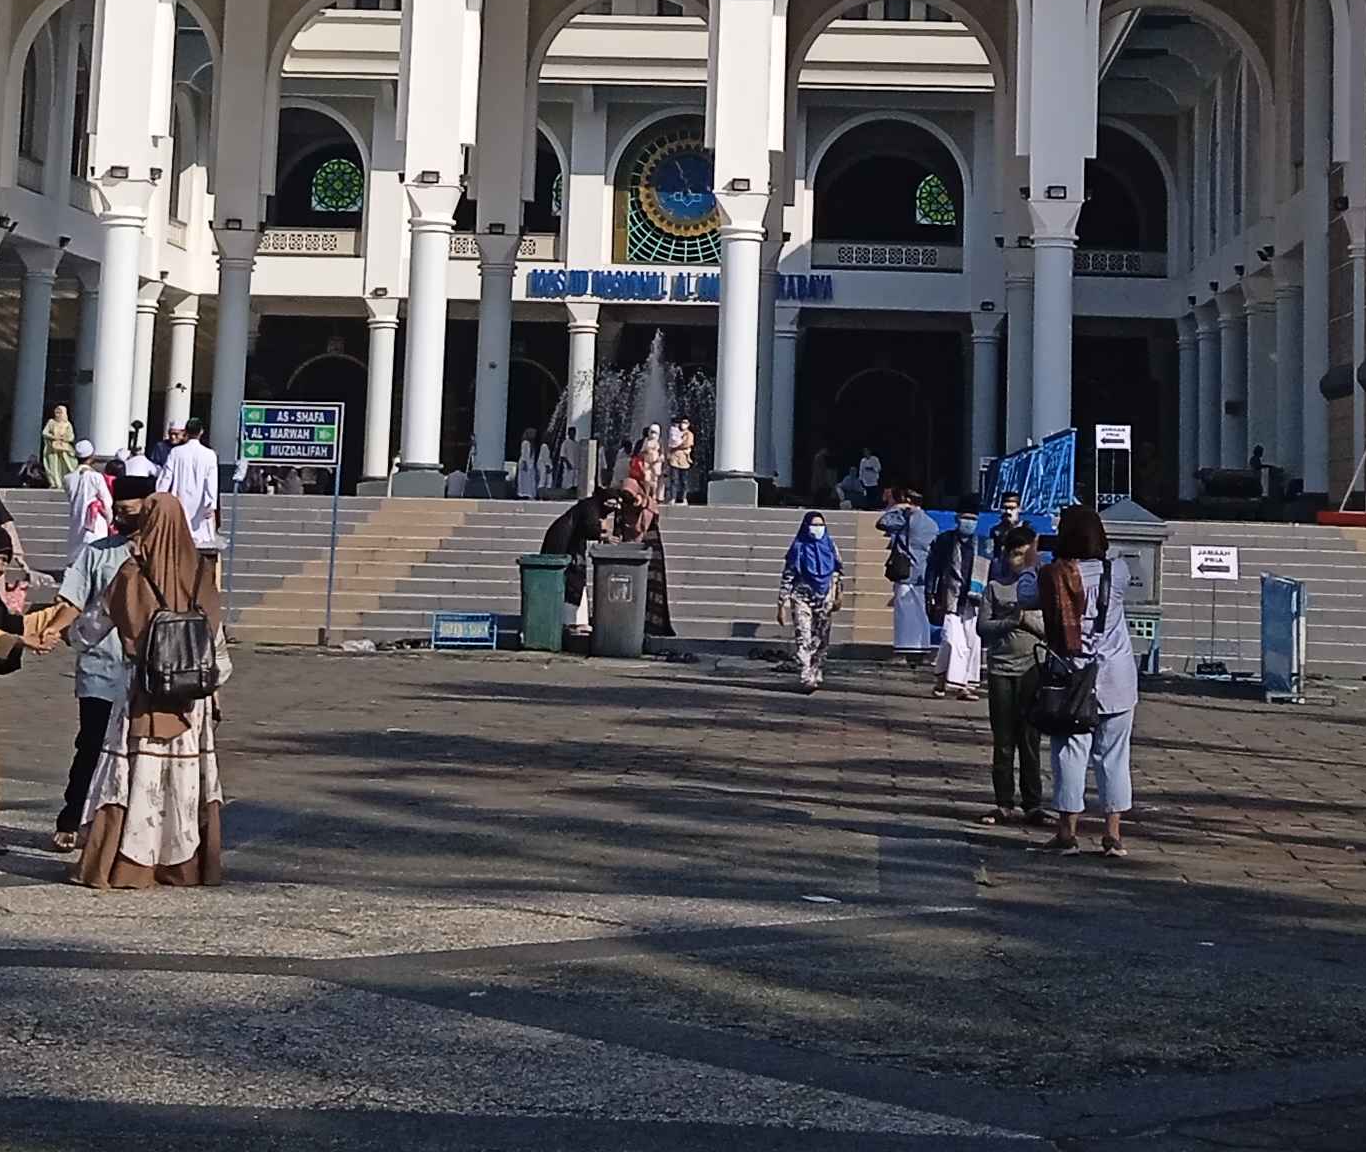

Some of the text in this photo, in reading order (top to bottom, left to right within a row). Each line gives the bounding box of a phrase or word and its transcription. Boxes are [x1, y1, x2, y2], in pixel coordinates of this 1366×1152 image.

[276, 411, 289, 423] AS
[295, 412, 325, 423] SHAFA
[251, 427, 263, 439] AL
[269, 428, 310, 439] MARWAH
[270, 445, 328, 457] MUZDALIFAH
